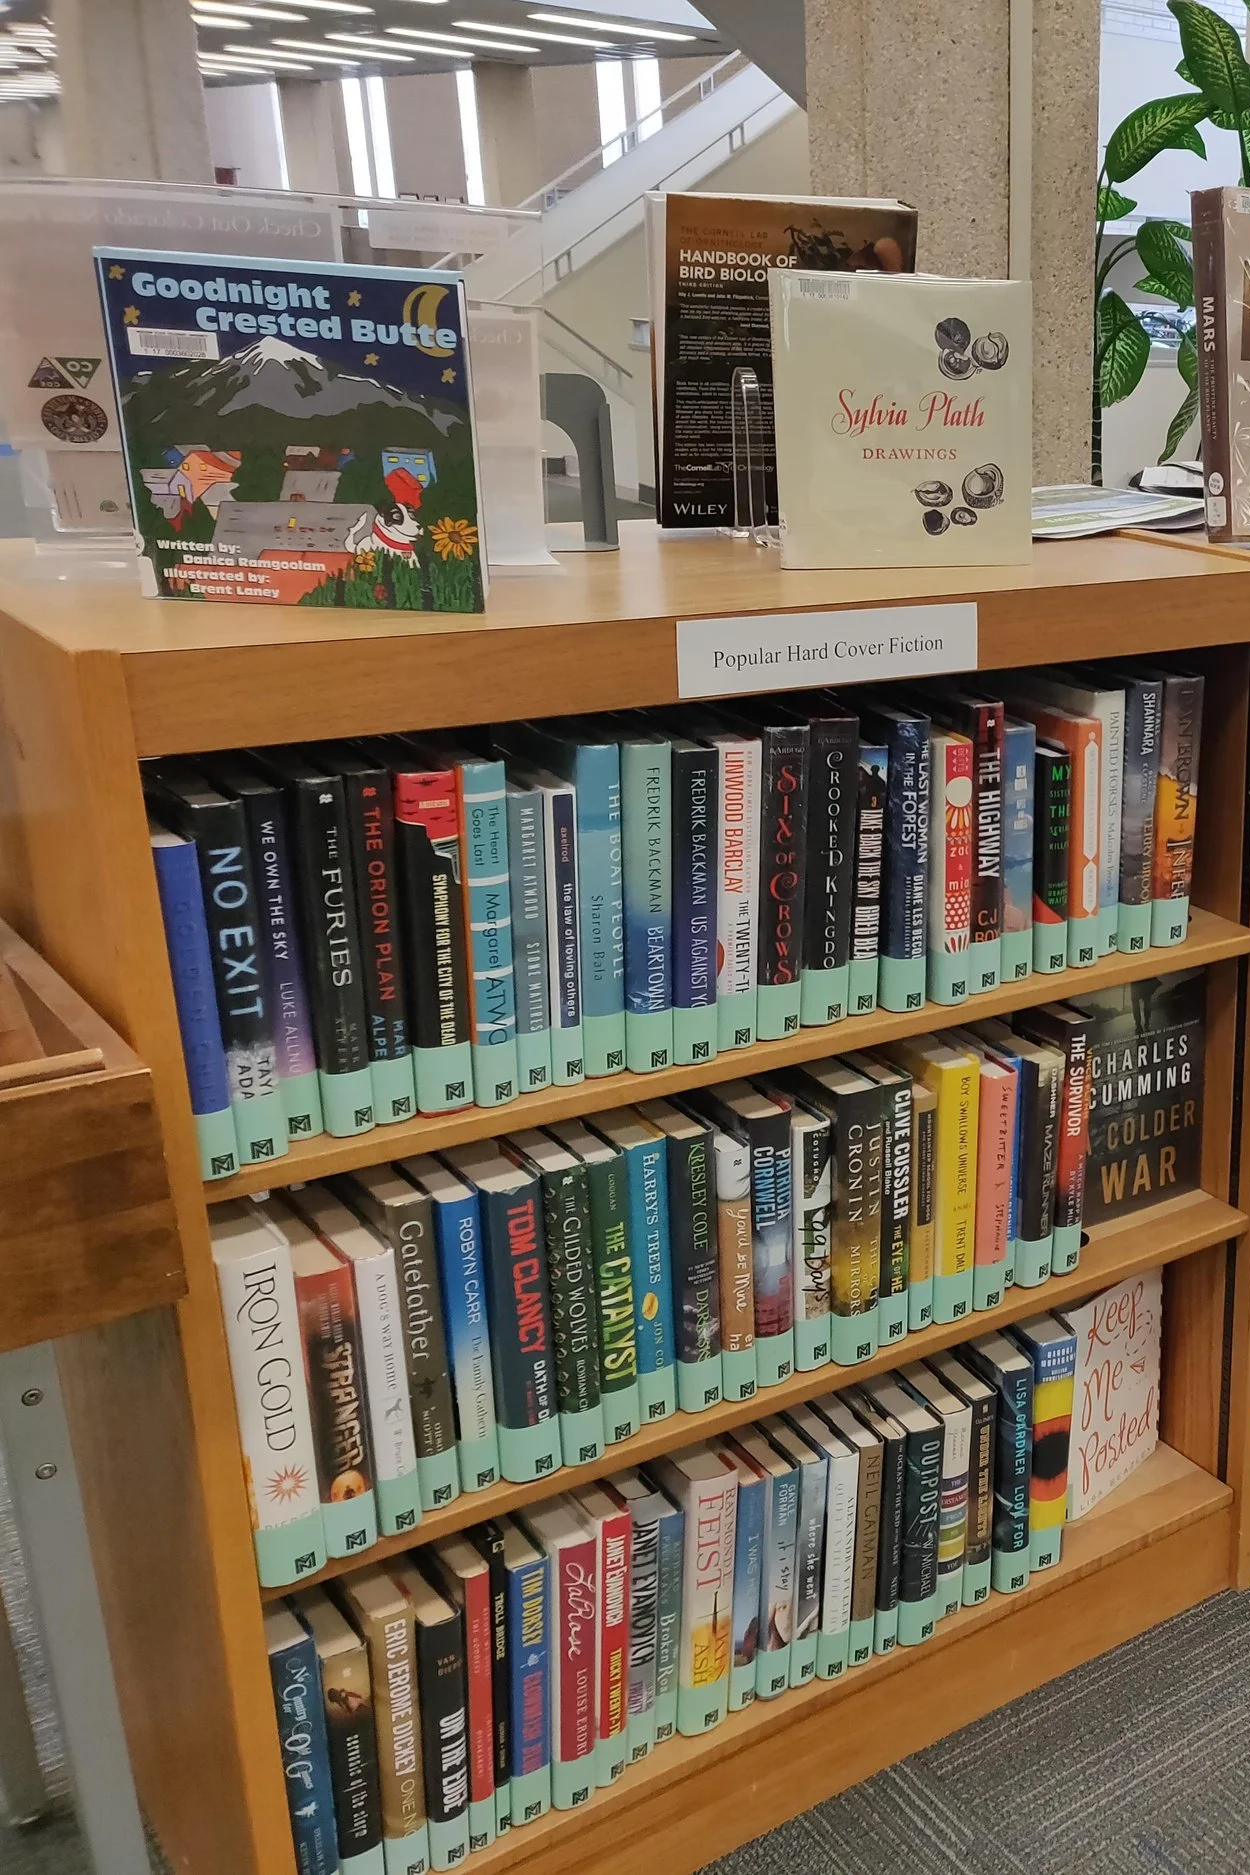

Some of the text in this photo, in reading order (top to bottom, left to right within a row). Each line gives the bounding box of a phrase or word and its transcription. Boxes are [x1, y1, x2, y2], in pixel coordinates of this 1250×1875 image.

[131, 272, 330, 310] Goodnight
[680, 249, 797, 268] HANDBOOK OF
[680, 266, 768, 282] BIRD BIOLO
[195, 306, 458, 349] Crested Butte
[1202, 296, 1215, 353] MARS
[831, 388, 985, 437] Sylvia Plath
[862, 448, 958, 460] DRAWINGS
[157, 539, 241, 555] Written by:
[674, 502, 728, 515] WILEY
[163, 569, 270, 585] Illustrated by:
[182, 555, 326, 572] Danica Ramgoolam
[189, 583, 280, 599] Brent Laney
[713, 635, 943, 671] Popular Hard Cover Fiction
[724, 751, 744, 894] LINWOOD BARCLAY
[977, 749, 1001, 878] THE HIGHWAY
[260, 820, 290, 961] WE OWN THE SKY
[321, 826, 353, 988] THE FURIES
[363, 807, 395, 1001] THE ORION PLAN
[607, 783, 624, 978] THE BOAT PEOPLE
[646, 767, 665, 1011] FREDRIK BACKMAN BEARTOWN
[769, 764, 798, 985] SIX OF CROWS
[207, 847, 263, 1019] NO EXIT
[432, 873, 456, 1045] SYMPHONY FOR THE CITY OF THE DEAD
[485, 893, 500, 971] Margaret
[1066, 1033, 1087, 1138] THE SURVIVOR
[1092, 1034, 1189, 1079] CHARLES
[866, 1122, 880, 1218] JUSTIN
[892, 1088, 911, 1220] CLIVE CUSSLER
[1106, 1100, 1196, 1151] COLDER
[753, 1146, 774, 1231] CORNWELL
[775, 1147, 791, 1222] PATRICIA
[848, 1123, 864, 1224] CRONIN
[1101, 1146, 1177, 1205] WAR
[399, 1220, 433, 1361] Gatefather
[458, 1216, 482, 1326] ROBYN CARR
[506, 1199, 546, 1355] TOM CLANCY
[563, 1216, 583, 1285] GILDED
[567, 1288, 588, 1354] WOLVES
[599, 1221, 637, 1382] THE CATALYST
[1084, 1280, 1144, 1367] Keep
[236, 1262, 298, 1453] IRON GOLD
[1080, 1359, 1123, 1428] Me
[918, 1440, 941, 1526] OUTPOST
[1012, 1379, 1030, 1550] LISA GARDNER LOOK FOR
[1078, 1386, 1155, 1496] Posted
[696, 1497, 725, 1589] FEIST
[863, 1455, 880, 1581] NEIL GAIMAN
[565, 1562, 595, 1660] LaRose
[605, 1535, 626, 1628] JANET EVANOVICH
[384, 1619, 416, 1777] ERIC JEROME DICKEY
